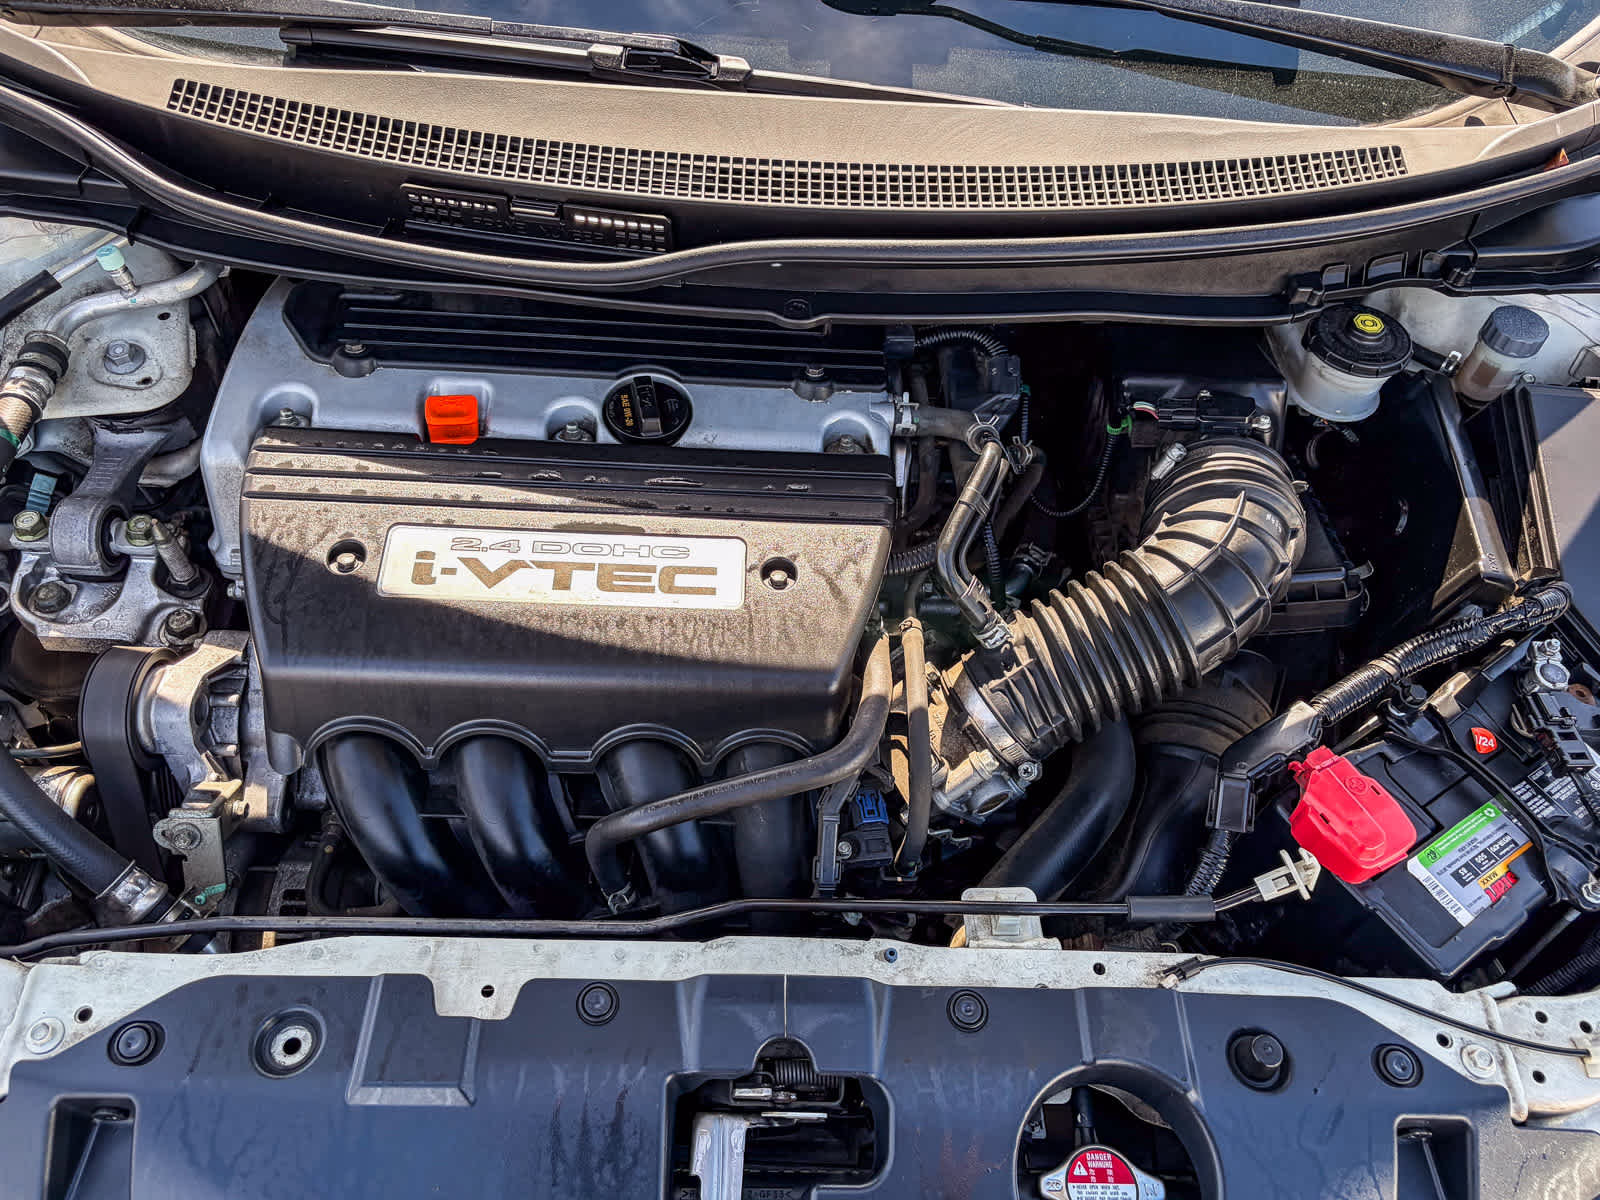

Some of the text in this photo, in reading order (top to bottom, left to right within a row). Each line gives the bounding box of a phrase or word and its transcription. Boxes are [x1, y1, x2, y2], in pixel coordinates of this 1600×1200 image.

[621, 394, 631, 408] SAE
[450, 536, 691, 560] 2.4 DOHC
[411, 550, 718, 596] i-VTEC
[1480, 871, 1499, 886] MAXX
[1086, 1152, 1112, 1161] DANGER
[1087, 1160, 1113, 1169] WARNING
